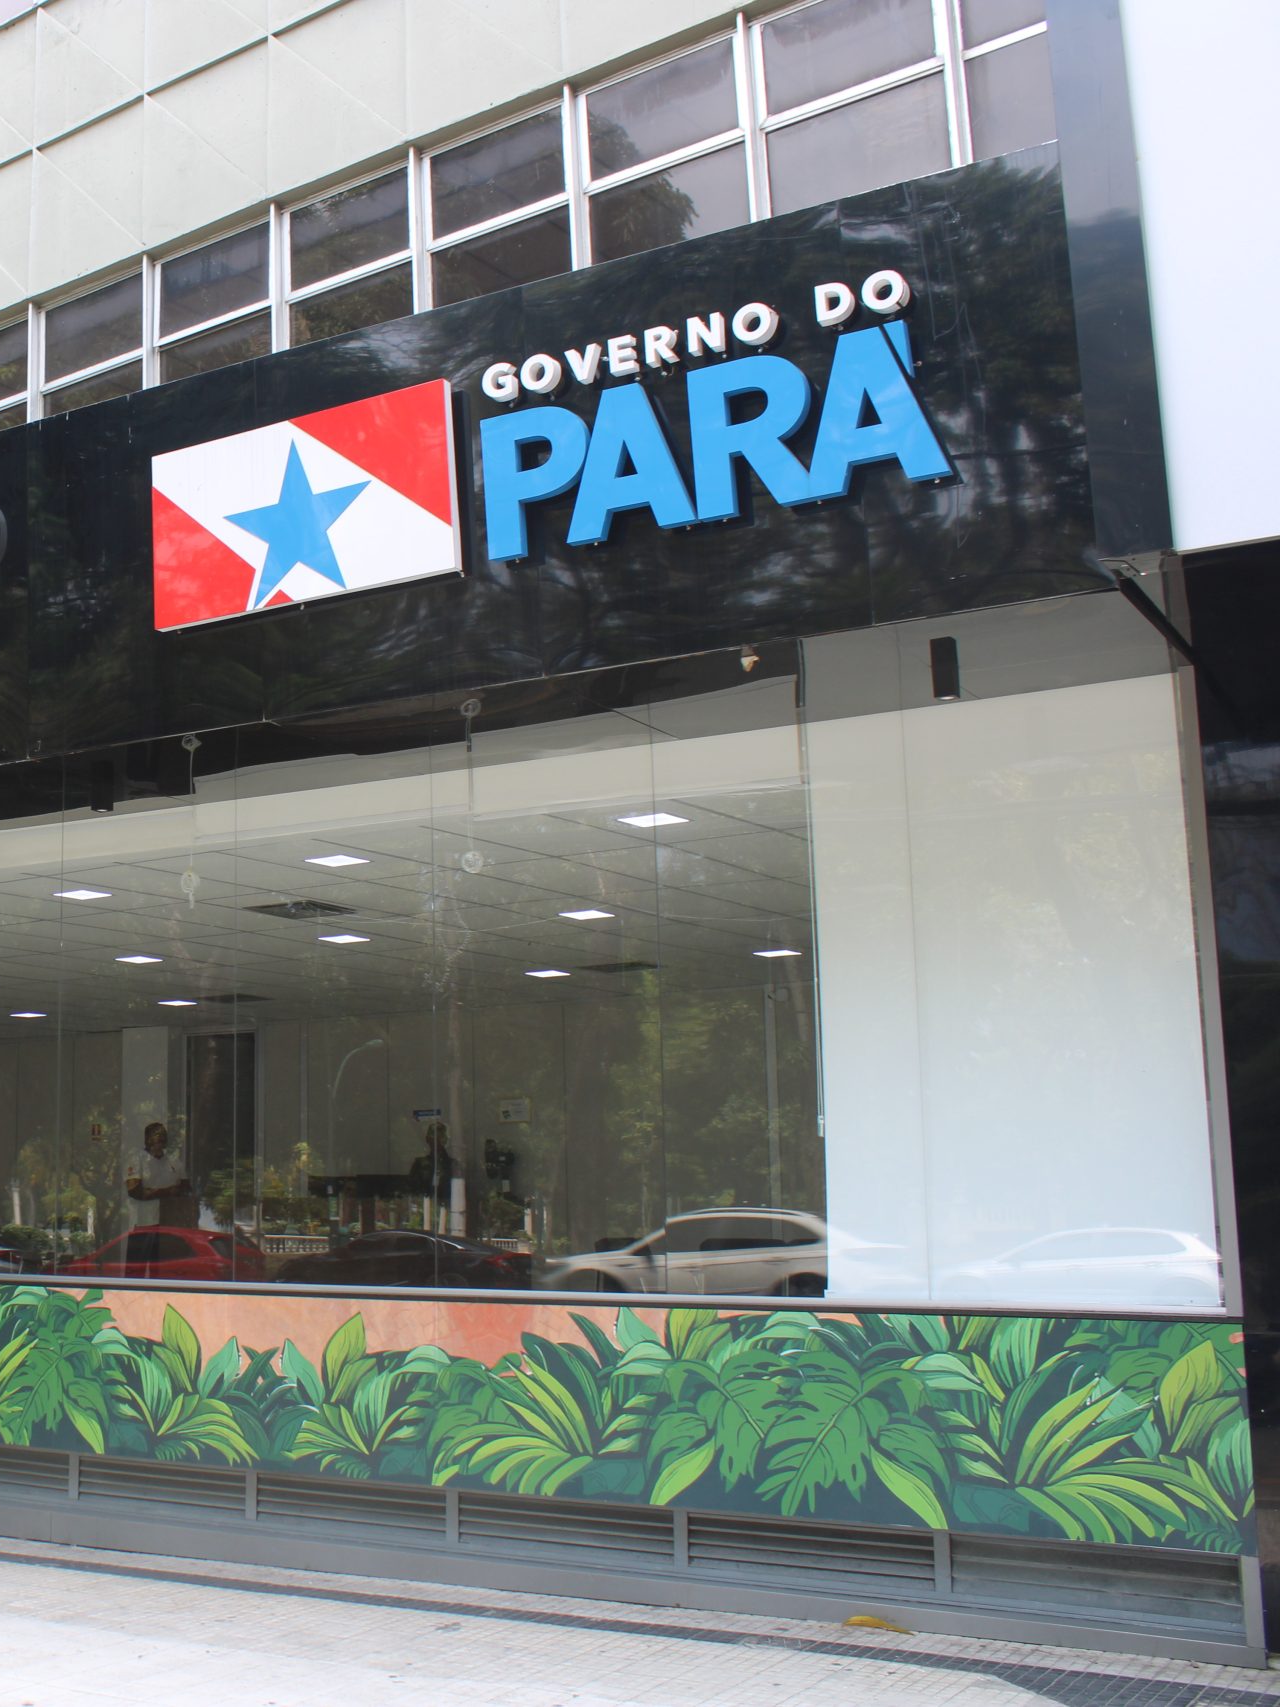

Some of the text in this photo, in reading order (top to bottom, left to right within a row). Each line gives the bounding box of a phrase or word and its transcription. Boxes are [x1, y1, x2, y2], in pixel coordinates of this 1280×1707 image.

[481, 269, 911, 403] GOVERNO DO
[480, 319, 954, 563] PARÁ
